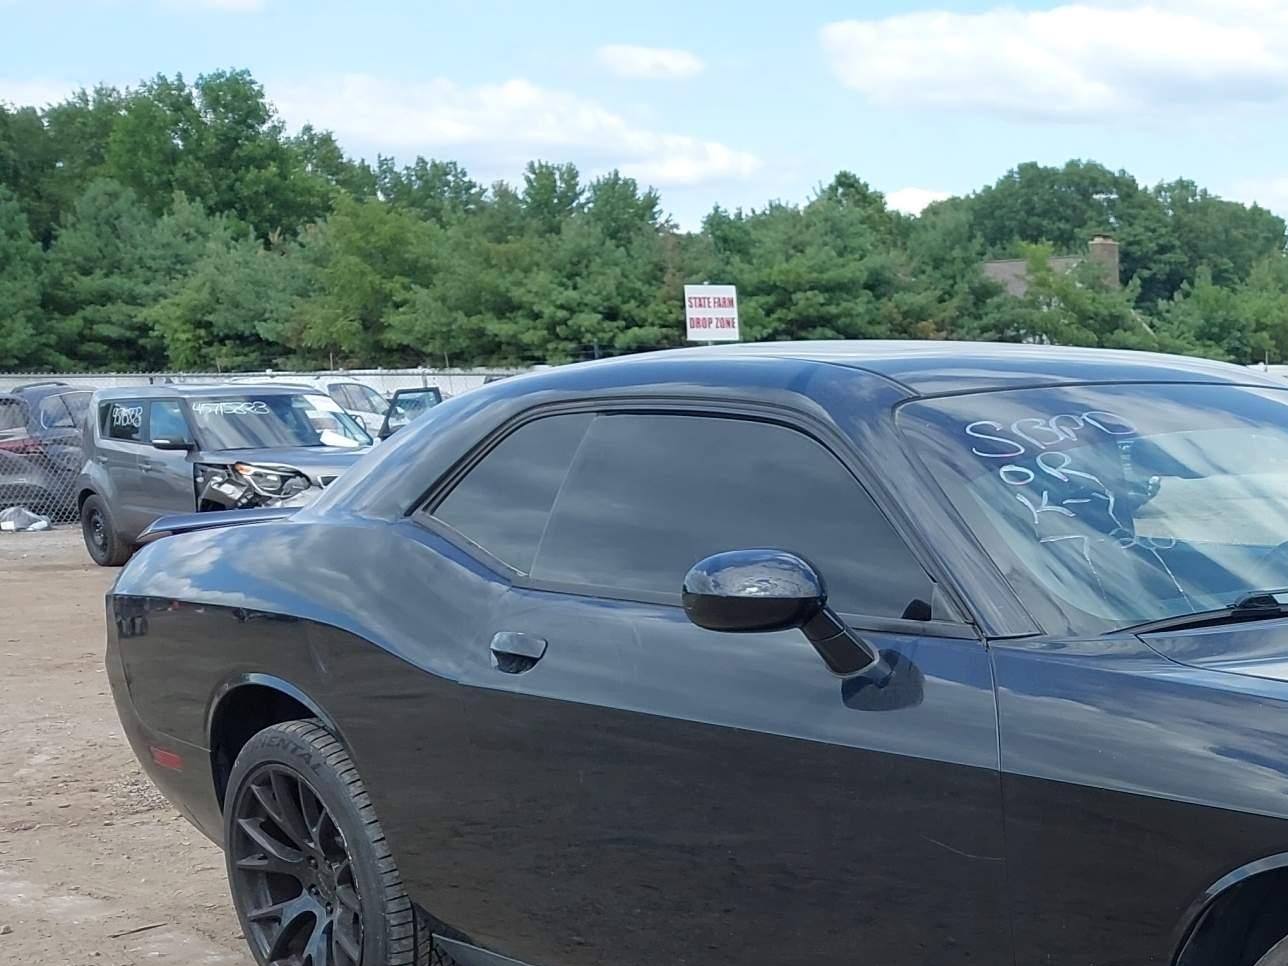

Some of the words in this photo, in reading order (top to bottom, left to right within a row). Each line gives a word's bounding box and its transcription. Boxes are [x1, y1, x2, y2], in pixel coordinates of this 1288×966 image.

[688, 296, 711, 308] STATE
[713, 296, 735, 308] FARM
[689, 317, 713, 329] DROP
[715, 317, 736, 329] ZONE
